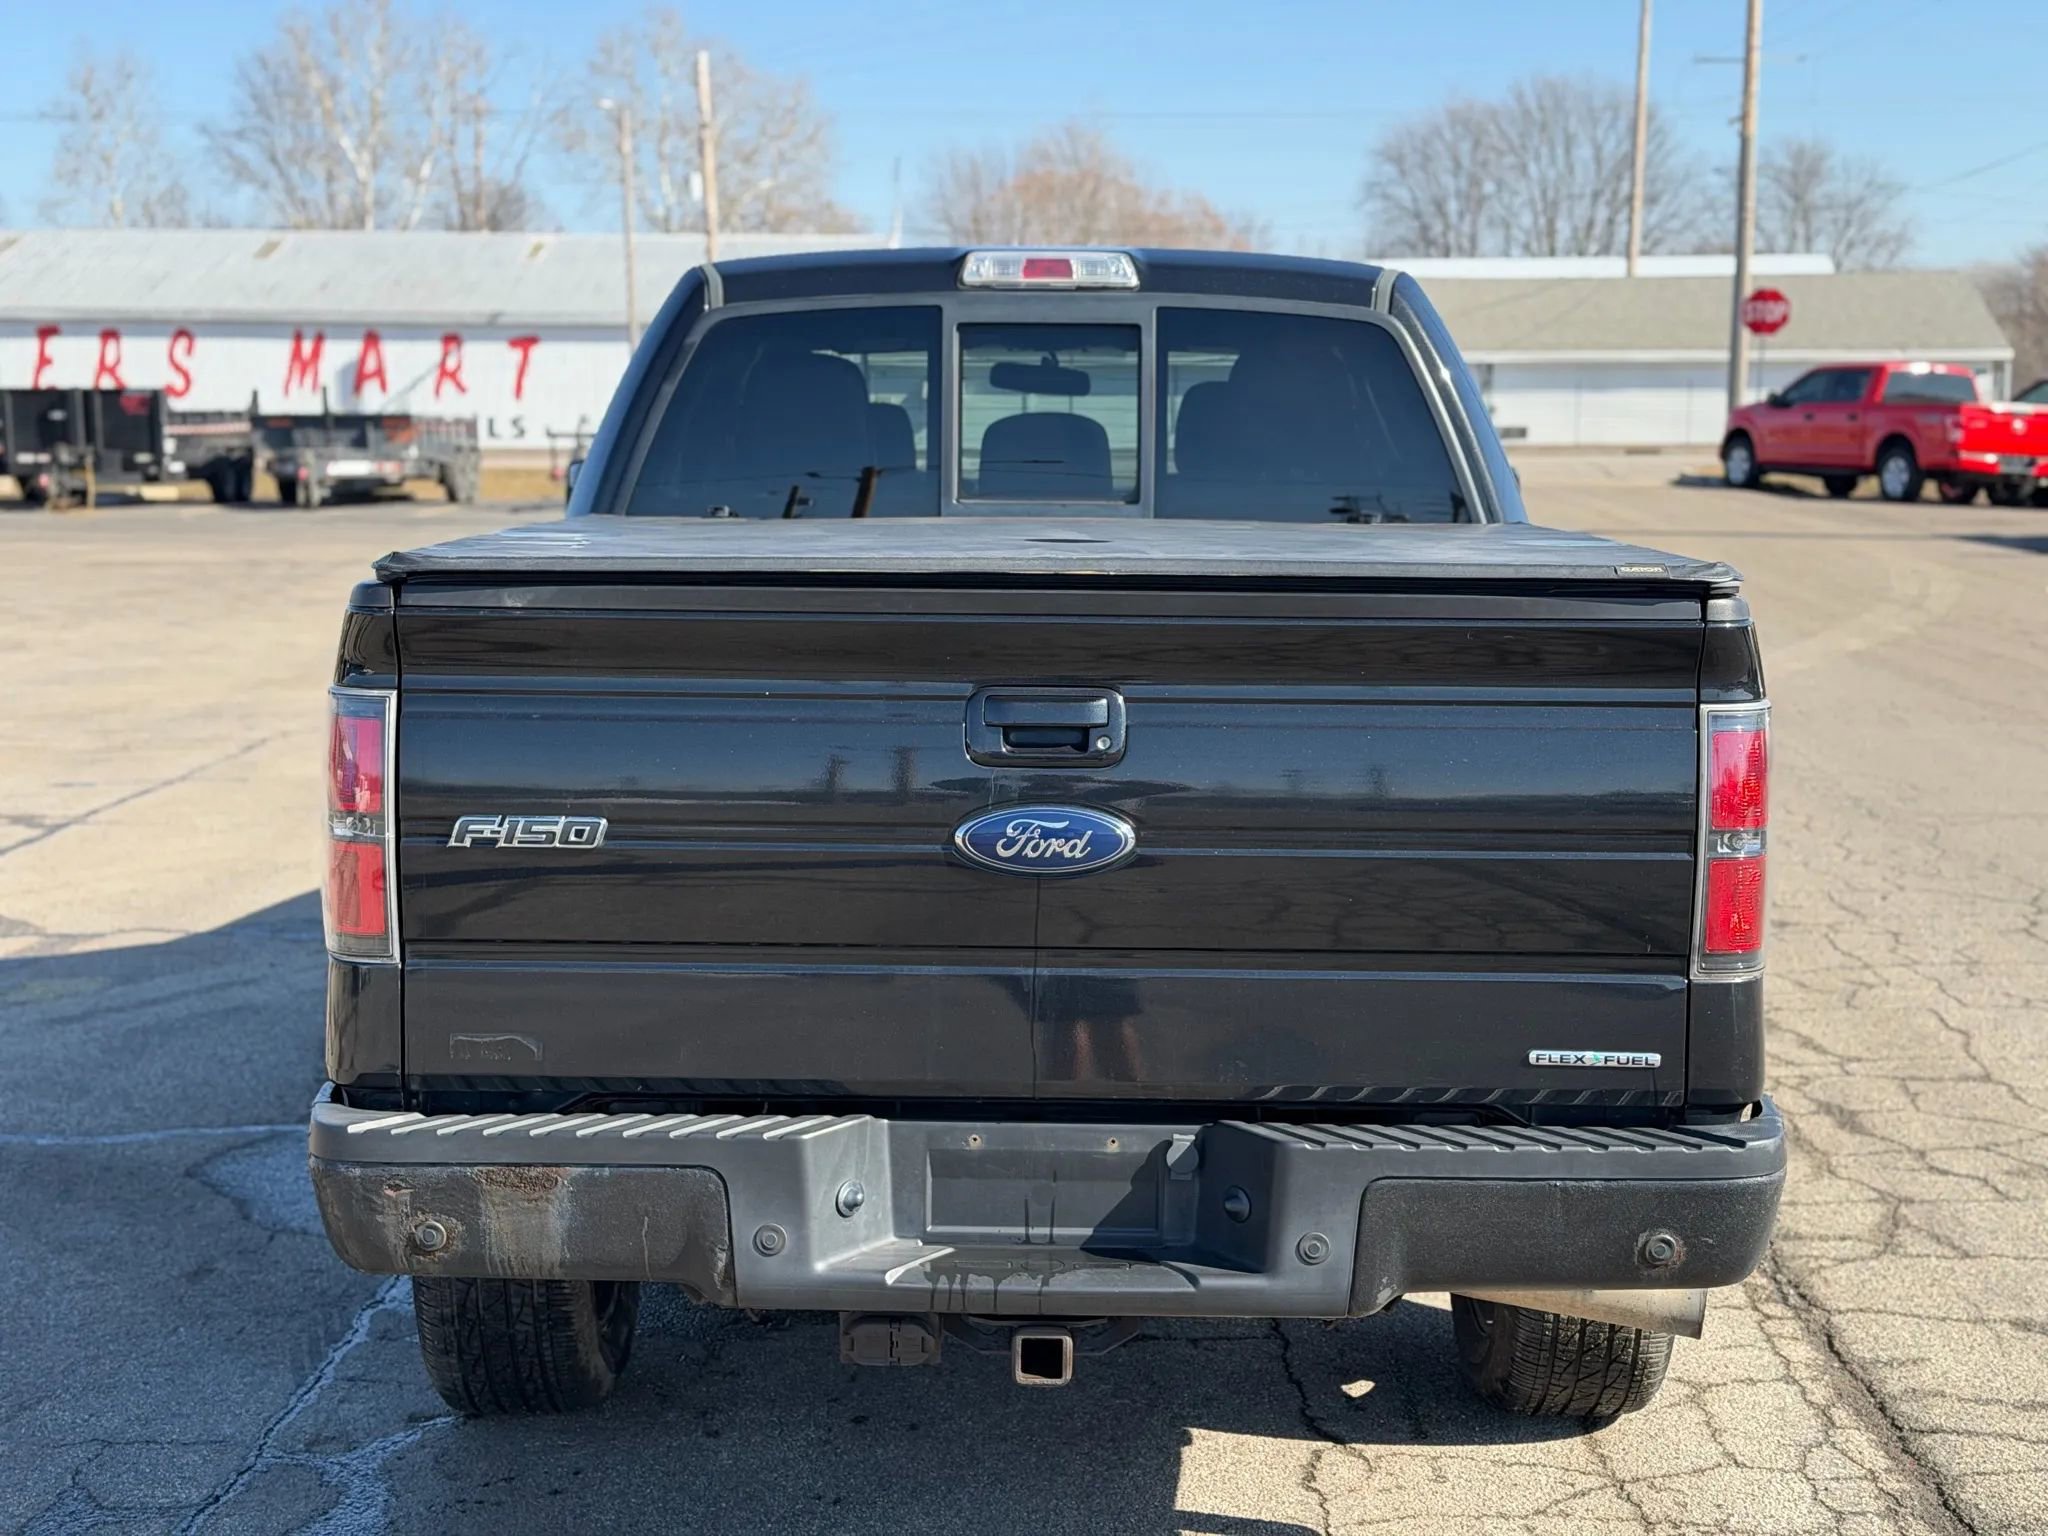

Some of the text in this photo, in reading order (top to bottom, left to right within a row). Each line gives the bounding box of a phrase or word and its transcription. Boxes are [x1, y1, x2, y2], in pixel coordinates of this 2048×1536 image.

[285, 329, 541, 399] MART
[447, 815, 609, 849] F-150
[995, 818, 1093, 859] Ford
[1535, 1053, 1656, 1067] FLEX FUEL
